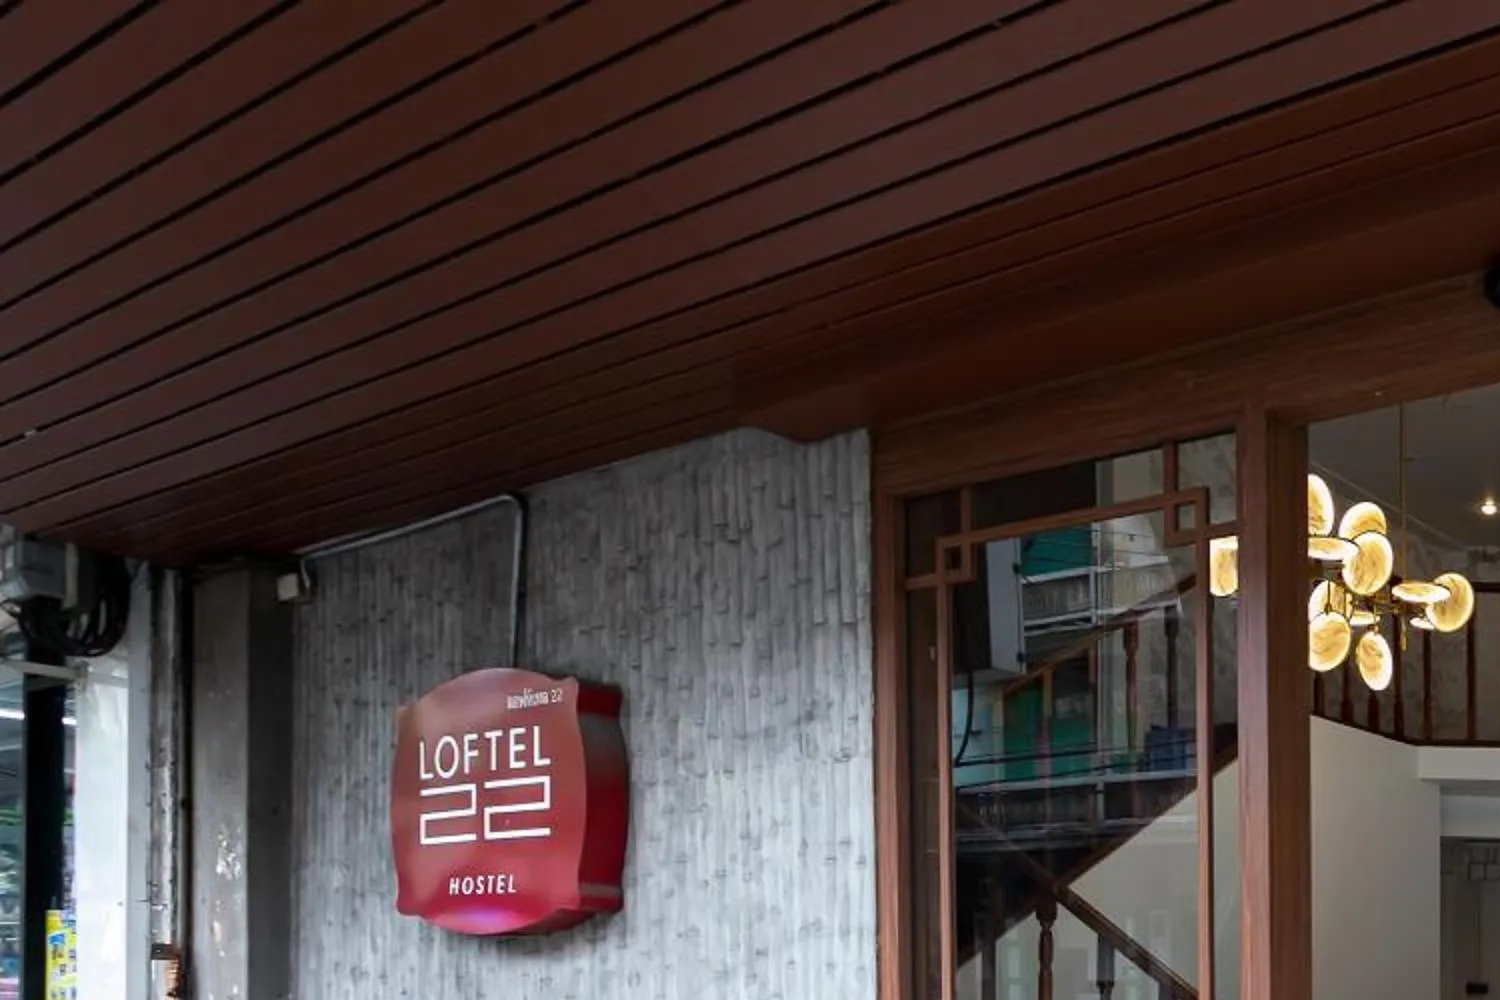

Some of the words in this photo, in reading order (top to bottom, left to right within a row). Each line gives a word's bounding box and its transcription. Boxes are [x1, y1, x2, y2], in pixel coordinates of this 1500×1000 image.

[419, 725, 551, 780] LOFTEL
[420, 775, 551, 845] 22
[449, 874, 517, 895] HOSTEL
